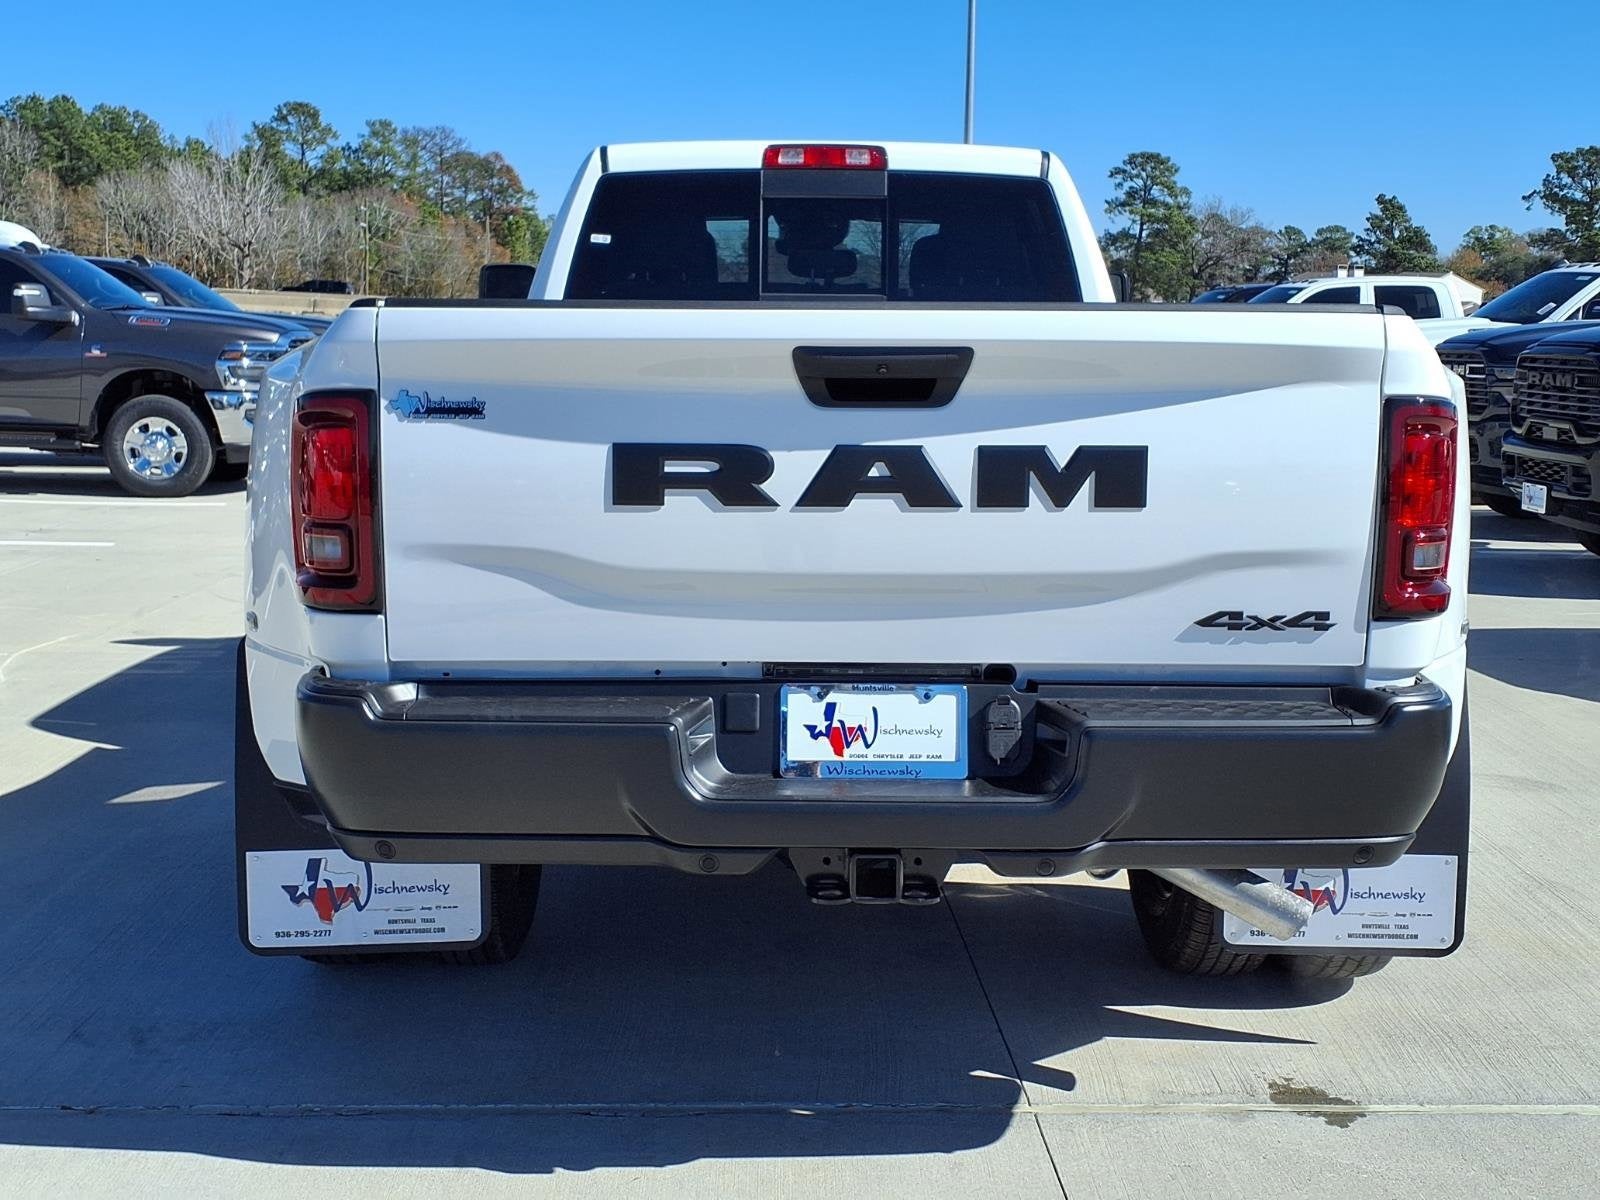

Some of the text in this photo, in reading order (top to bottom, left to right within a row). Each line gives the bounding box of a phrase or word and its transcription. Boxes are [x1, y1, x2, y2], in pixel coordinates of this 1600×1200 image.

[1528, 372, 1573, 388] RAM
[611, 442, 1149, 508] RAM
[851, 684, 895, 692] Huntsville
[837, 706, 943, 749] Wischnewsky
[826, 762, 922, 778] Wischnewsky
[323, 861, 450, 912] Wischnewsky
[274, 929, 332, 939] 936-295-2277
[373, 926, 446, 936] WISCHNEWSKYDODGE.COM
[1347, 932, 1419, 940] WISCHNEWSKYDODGE.COM
